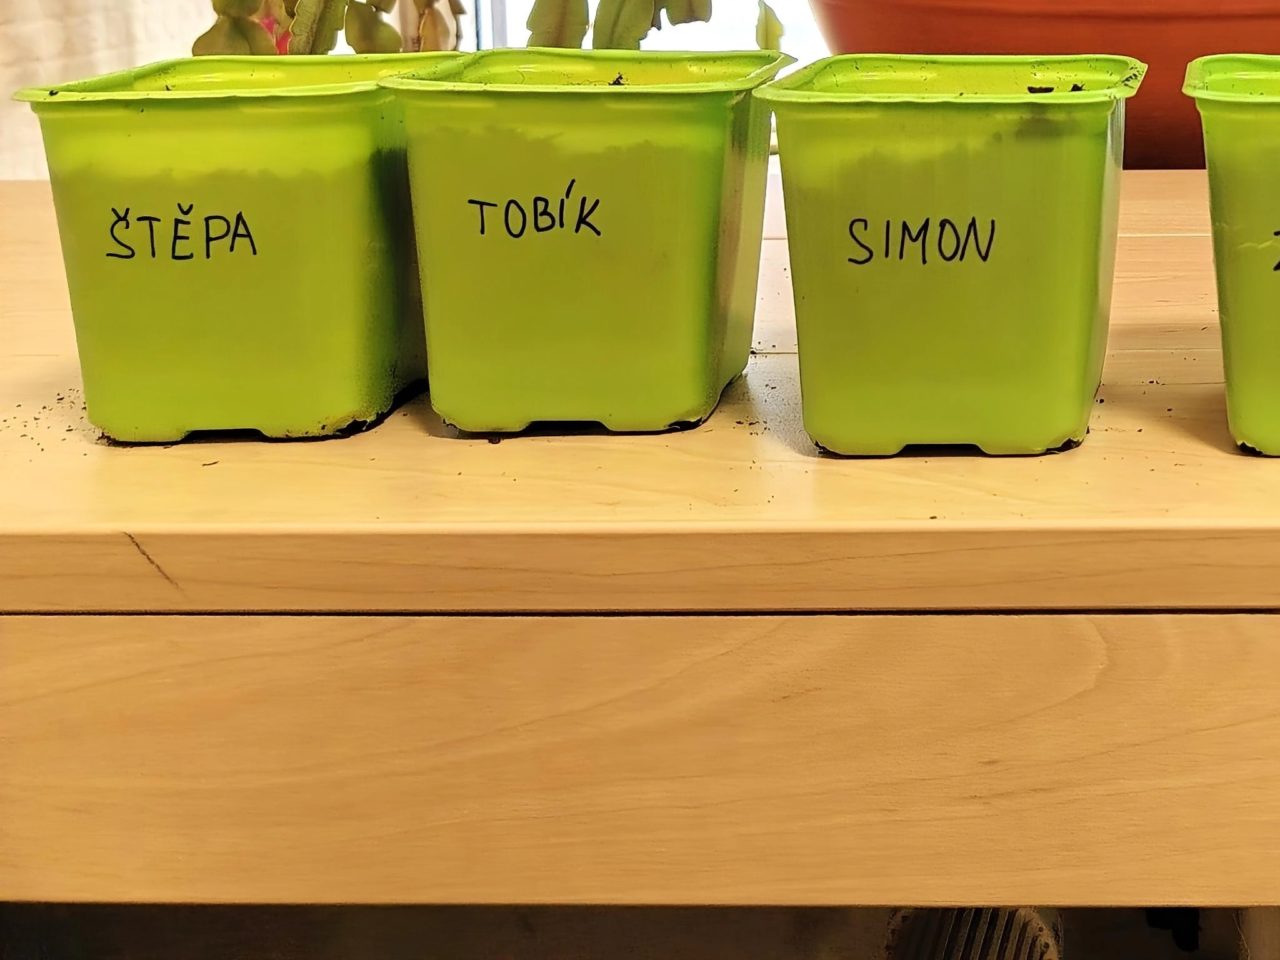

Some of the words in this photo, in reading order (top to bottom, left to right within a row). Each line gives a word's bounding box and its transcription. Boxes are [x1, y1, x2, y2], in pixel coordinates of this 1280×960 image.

[106, 203, 258, 261] ŠTĚPA
[467, 179, 602, 238] TOBÍK
[848, 216, 996, 266] SIMON
